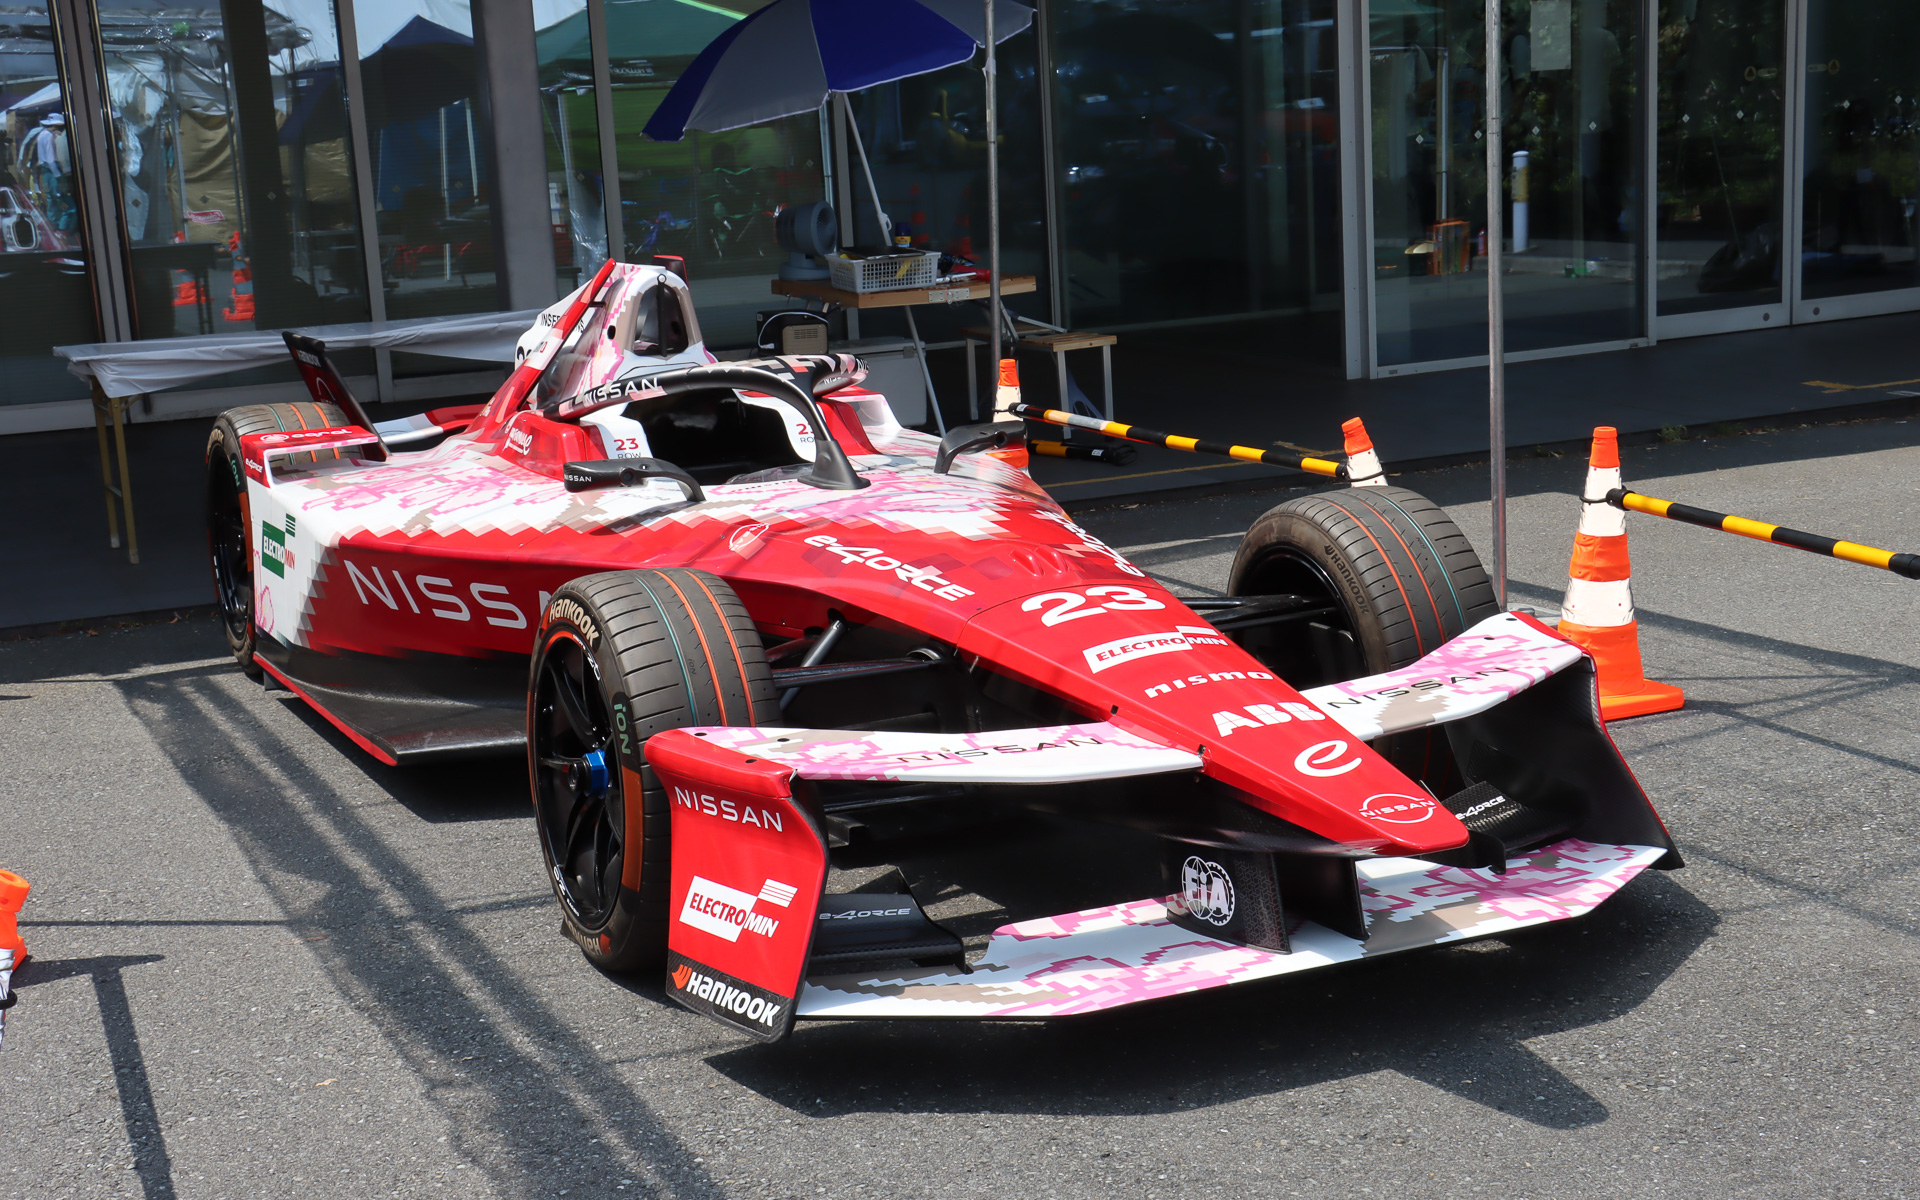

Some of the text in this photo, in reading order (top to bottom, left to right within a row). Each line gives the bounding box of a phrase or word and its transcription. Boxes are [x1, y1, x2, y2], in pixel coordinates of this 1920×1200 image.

[584, 377, 658, 407] NISSAN
[614, 438, 639, 451] 23
[563, 474, 592, 483] NISSAN
[1021, 586, 1166, 627] 23
[1095, 636, 1229, 662] ELECTROMIN
[1144, 671, 1274, 699] nismo
[1327, 667, 1510, 708] NISSAN
[1212, 702, 1326, 737] ABB
[897, 737, 1104, 763] NISSAN
[674, 786, 783, 832] NISSAN
[1360, 800, 1436, 818] NISSAN
[689, 891, 780, 938] ELECTROMIN
